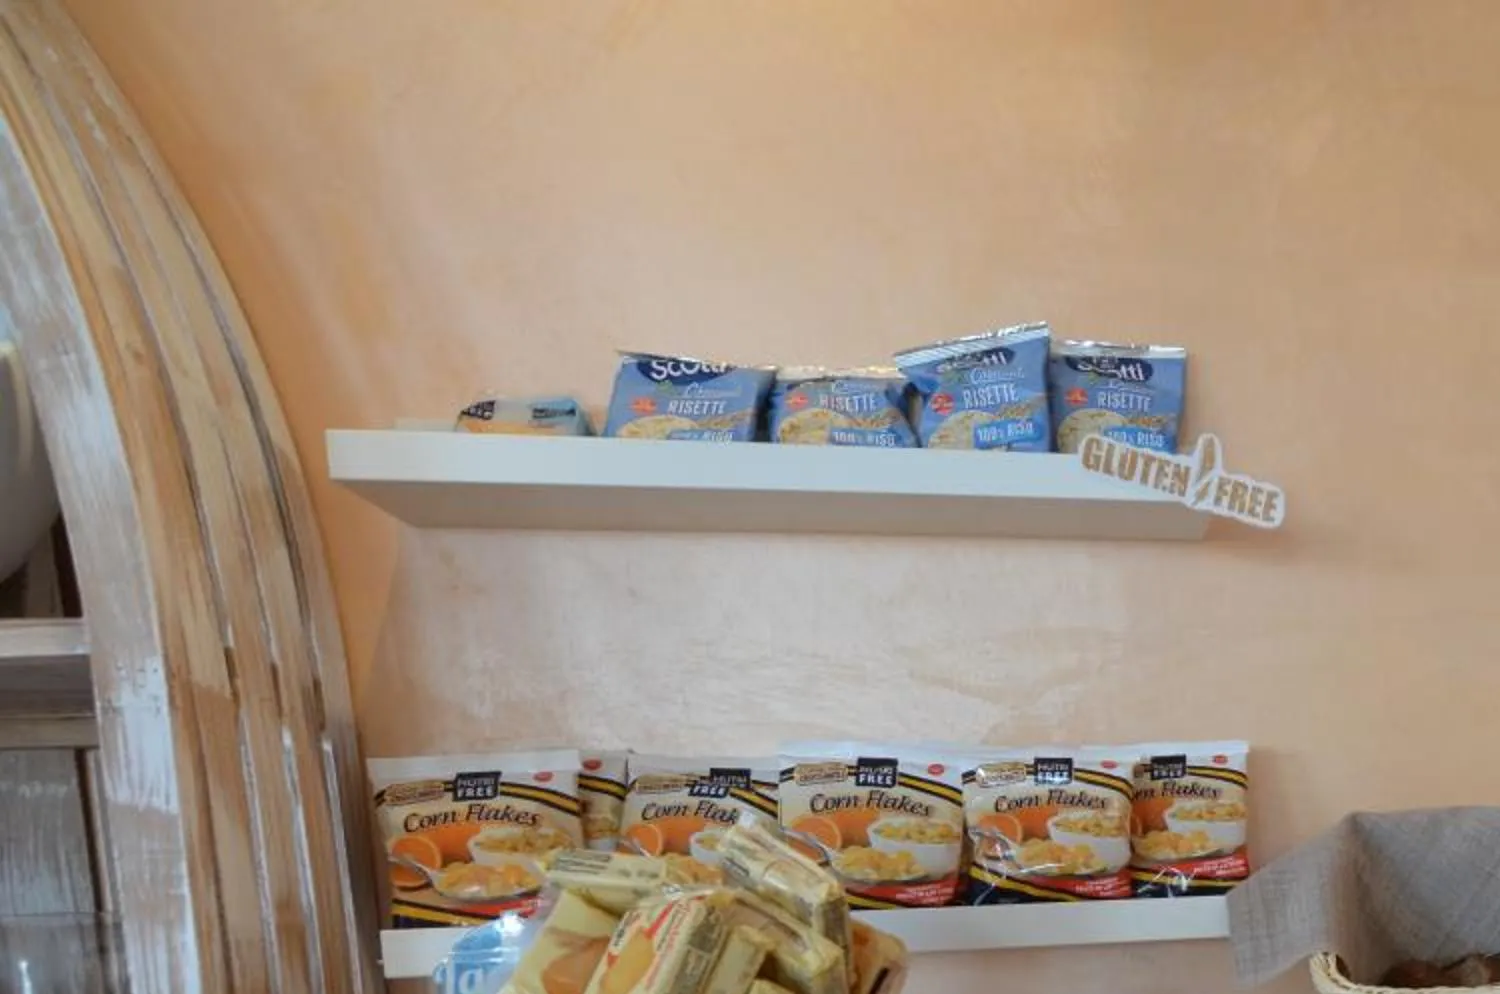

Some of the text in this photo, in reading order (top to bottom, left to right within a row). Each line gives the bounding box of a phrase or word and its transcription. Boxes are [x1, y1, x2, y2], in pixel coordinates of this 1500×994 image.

[820, 393, 877, 412] RISETTE
[963, 383, 1020, 410] RISETTE
[1097, 391, 1152, 412] RISETTE
[667, 400, 727, 416] RISETTE
[1081, 437, 1281, 523] GLUTEN FREE
[693, 785, 725, 796] FREE
[858, 775, 893, 785] FREE
[1160, 781, 1223, 800] Flakes
[458, 786, 494, 797] FREE
[995, 789, 1108, 813] Corn Flakes
[641, 800, 740, 825] Corn Flak
[810, 790, 934, 817] Corn Flakes
[403, 803, 541, 833] Corn Flakes
